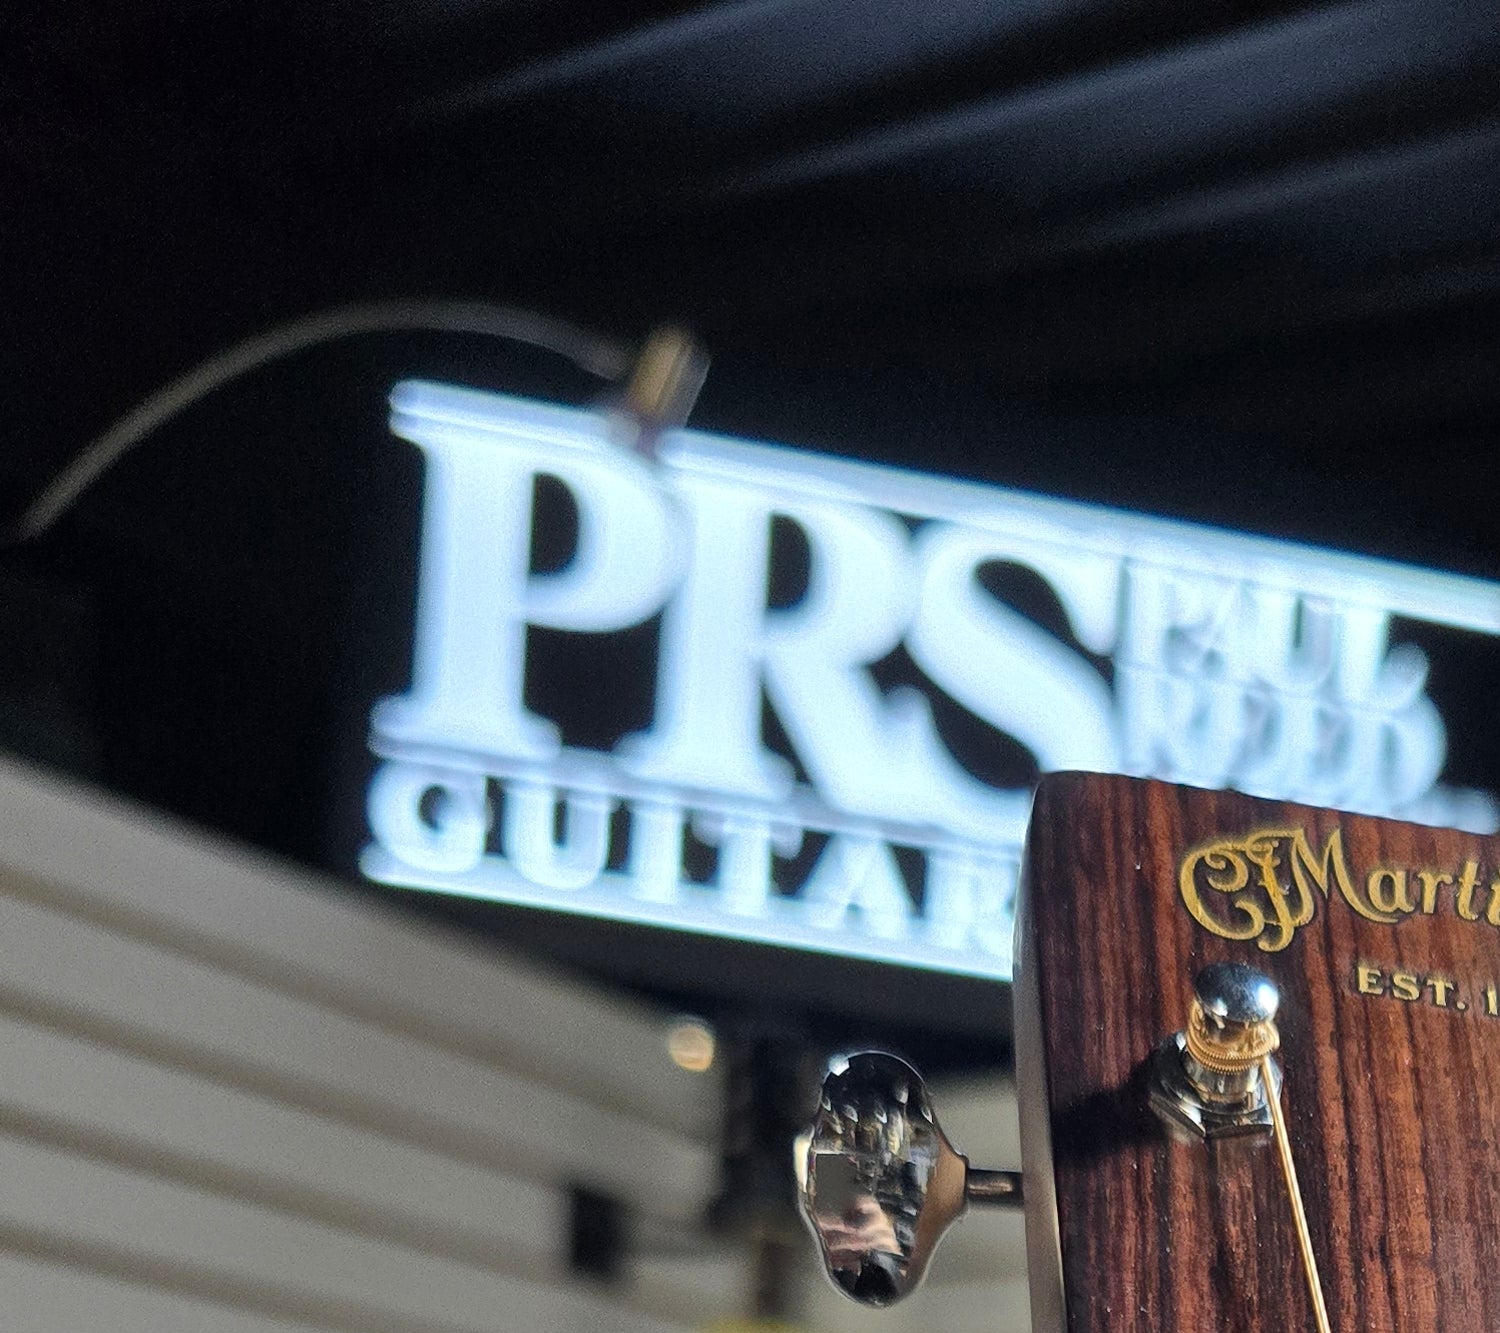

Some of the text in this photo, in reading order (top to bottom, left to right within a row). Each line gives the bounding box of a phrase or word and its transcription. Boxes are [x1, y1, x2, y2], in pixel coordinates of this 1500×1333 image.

[370, 395, 1122, 832] PRS
[364, 758, 1022, 964] GUITAR
[1356, 964, 1466, 1012] EST.
